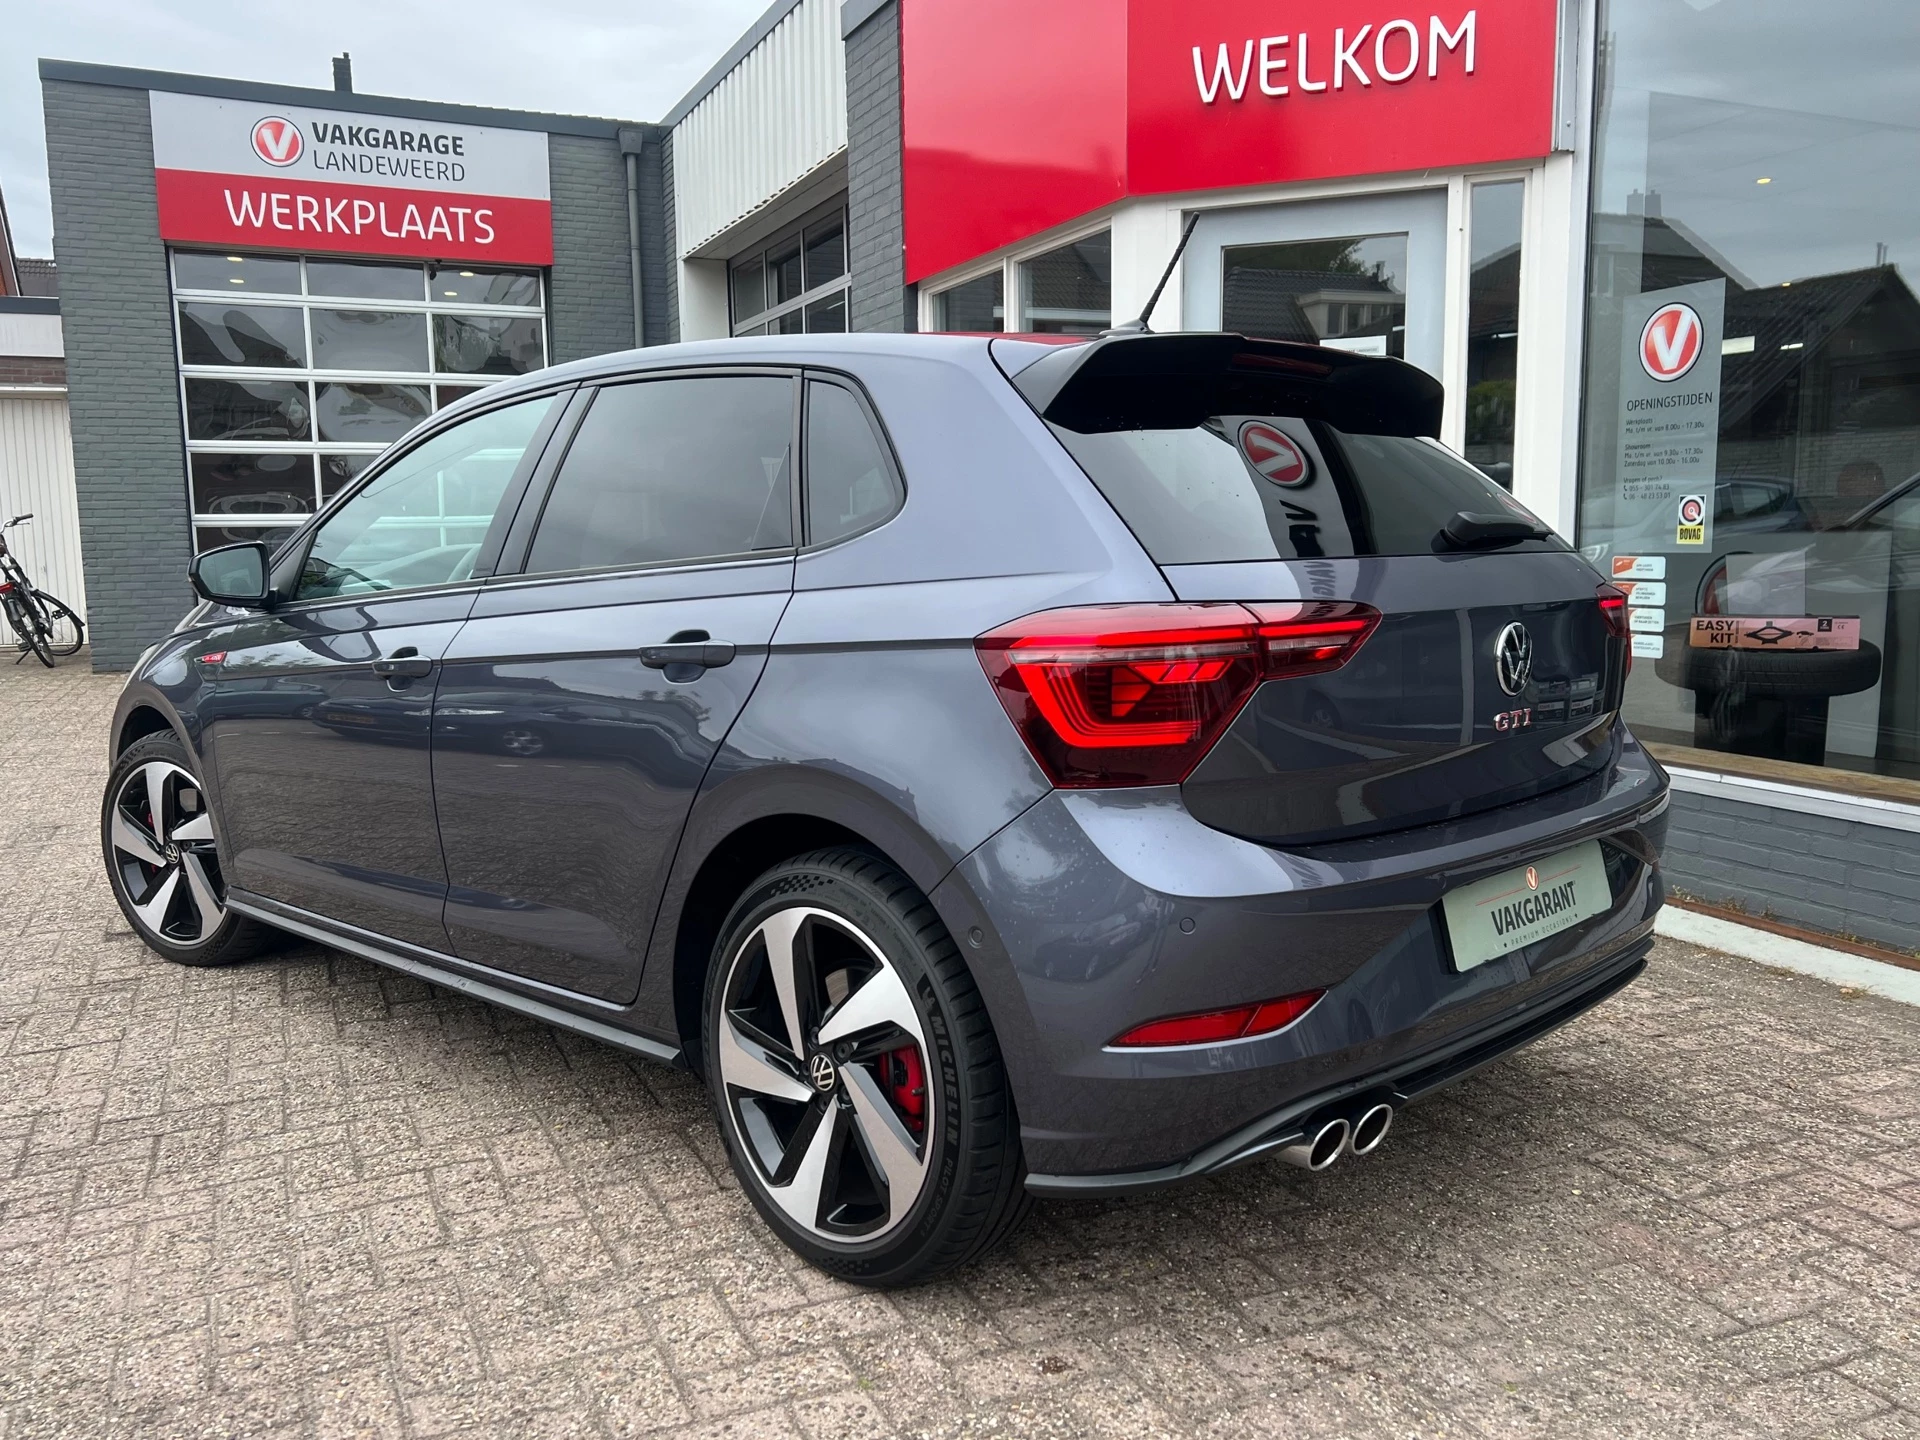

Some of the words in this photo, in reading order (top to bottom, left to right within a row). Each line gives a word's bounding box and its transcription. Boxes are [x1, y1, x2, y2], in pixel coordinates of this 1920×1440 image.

[1192, 10, 1476, 103] WELKOM
[311, 121, 465, 156] VAKGARAGE
[313, 149, 466, 182] LANDEWEERD
[223, 189, 496, 245] WERKPLAATS
[1627, 392, 1713, 411] OPENINGSTIJDEN
[1680, 528, 1702, 540] BOVAG
[1696, 620, 1734, 631] EASY
[1710, 632, 1734, 643] KIT
[1493, 707, 1531, 732] GTI
[1490, 880, 1577, 936] VAKGARANT
[1511, 930, 1539, 945] PREMIUM
[1542, 915, 1573, 934] OCCASIONS
[930, 1015, 959, 1147] MICHELIN
[940, 1157, 954, 1195] PILOT
[923, 1195, 943, 1231] SPORT
